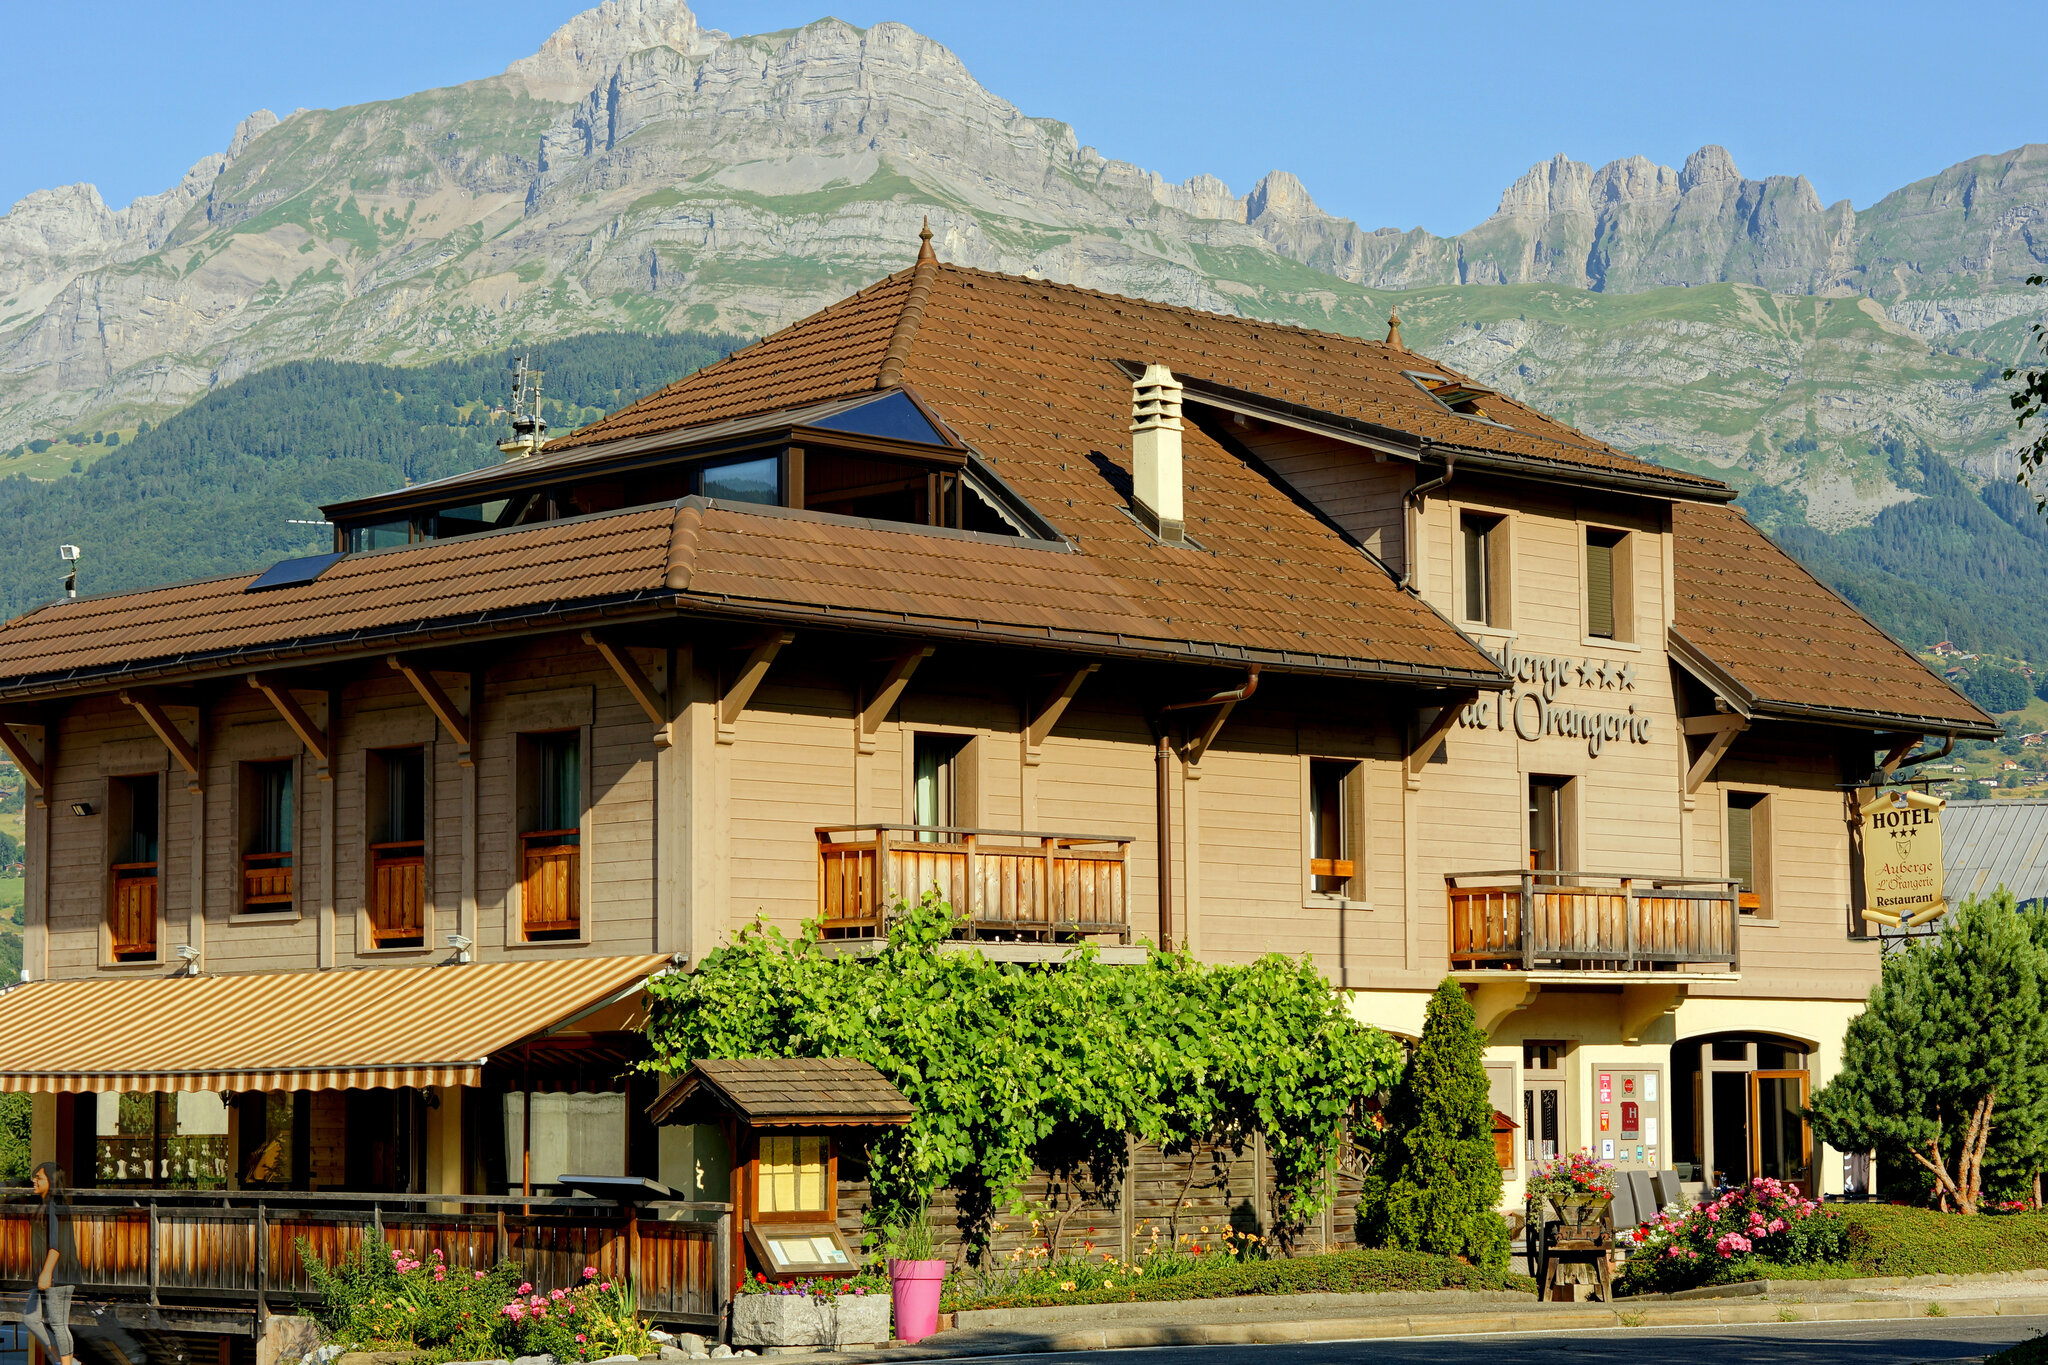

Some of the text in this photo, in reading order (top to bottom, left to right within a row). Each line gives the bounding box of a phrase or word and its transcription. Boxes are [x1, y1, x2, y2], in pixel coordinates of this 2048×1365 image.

[1477, 634, 1572, 702] berge
[1872, 808, 1933, 829] HOTEL
[1875, 861, 1933, 875] Auberge
[1876, 876, 1933, 890] L'Orangerie
[1876, 893, 1933, 906] Restaurant
[1629, 1107, 1637, 1118] H
